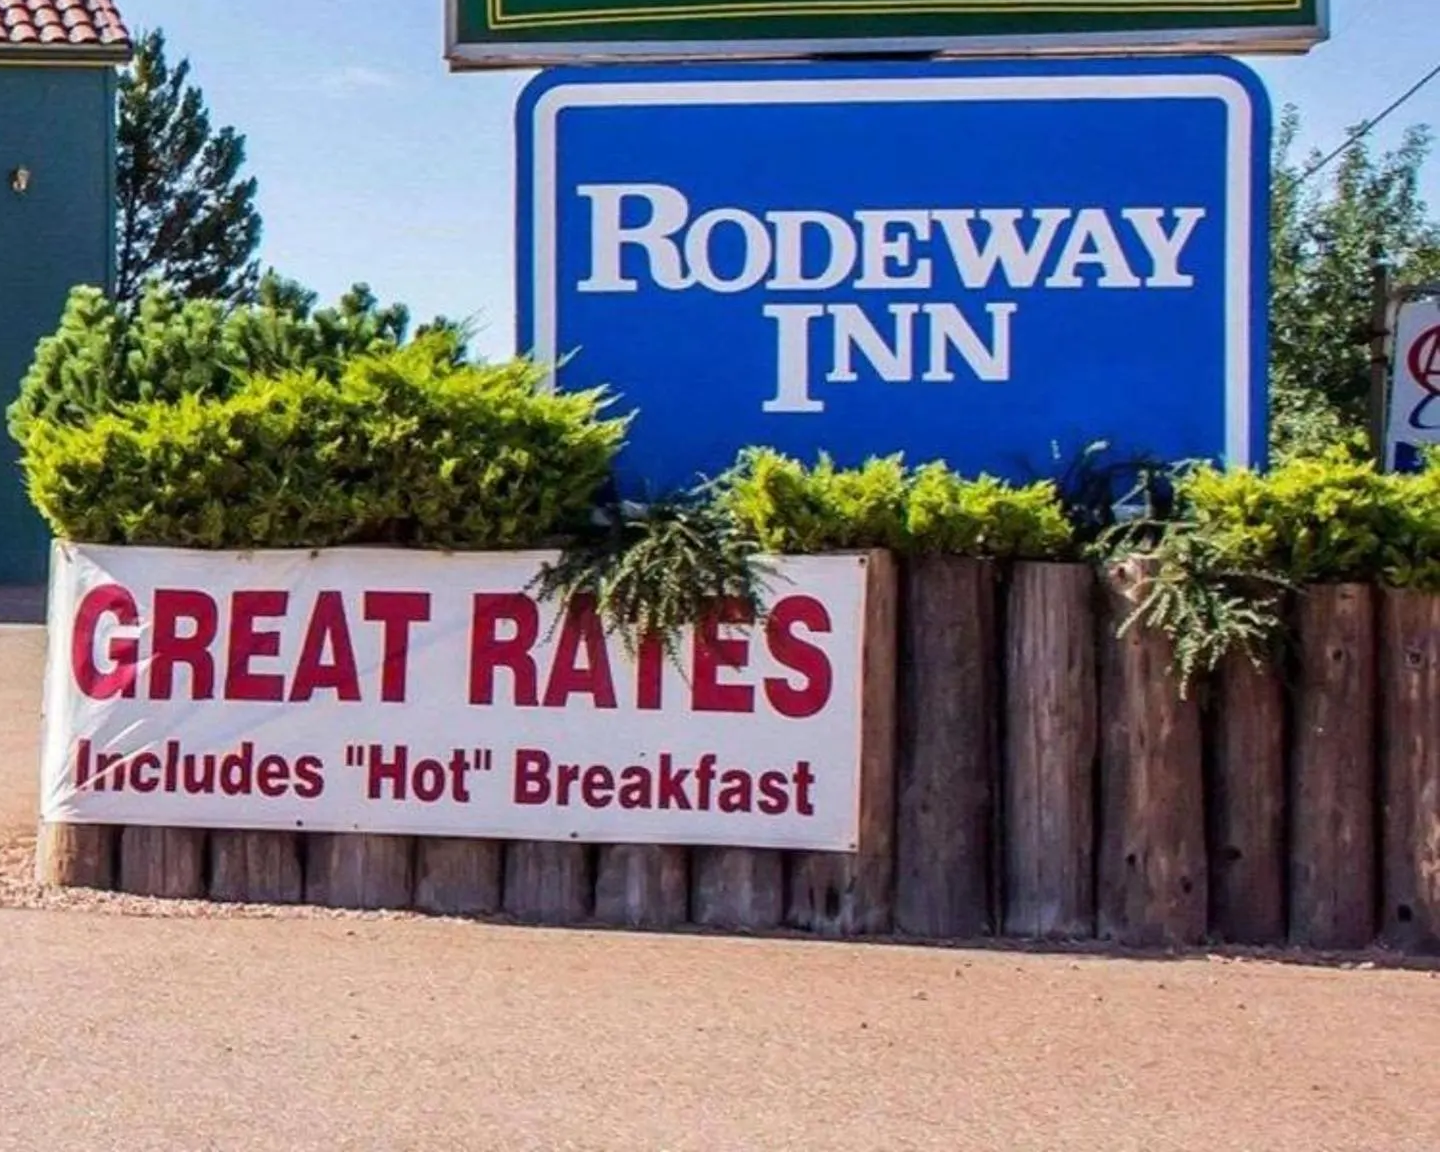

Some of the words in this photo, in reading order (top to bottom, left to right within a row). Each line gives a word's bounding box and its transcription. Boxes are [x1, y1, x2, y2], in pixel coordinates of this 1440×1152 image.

[576, 182, 1206, 294] RODEWAY
[762, 301, 1018, 414] INN
[71, 583, 431, 703] GREAT
[76, 739, 324, 799] Includes
[345, 743, 493, 803] "Hot"
[513, 748, 815, 817] Breakfast
